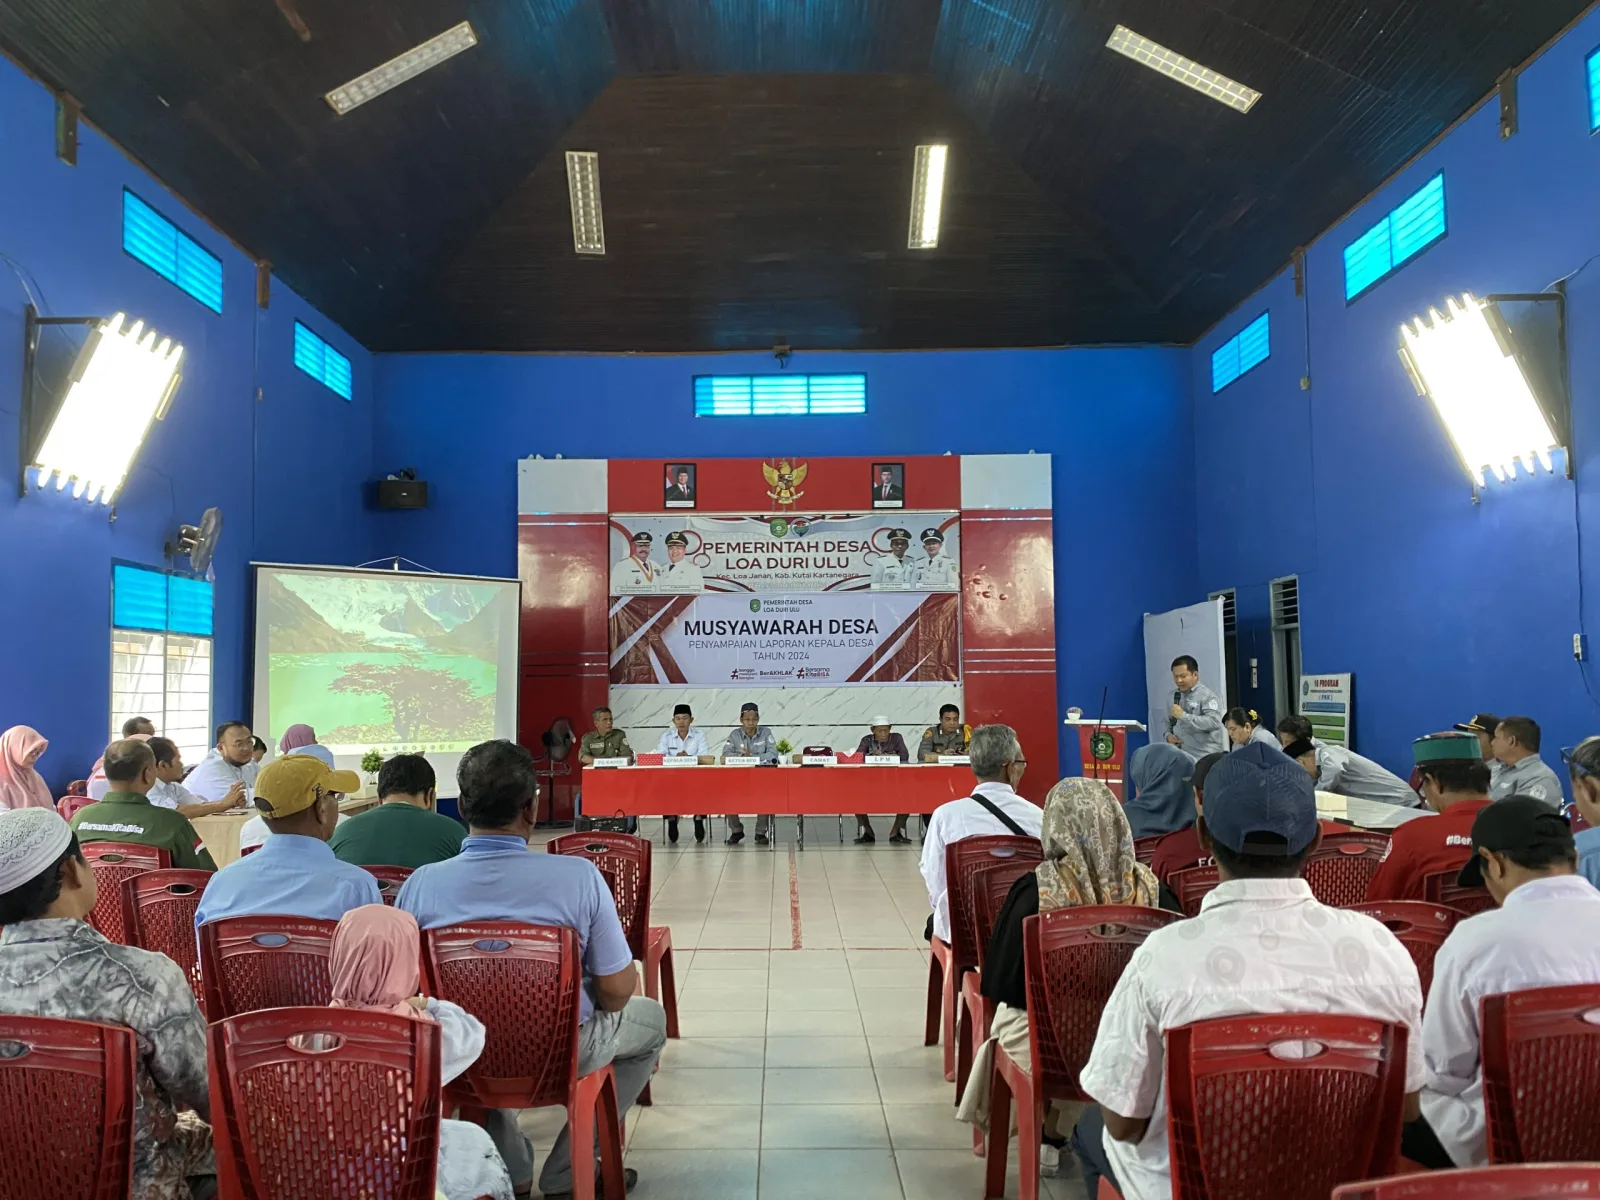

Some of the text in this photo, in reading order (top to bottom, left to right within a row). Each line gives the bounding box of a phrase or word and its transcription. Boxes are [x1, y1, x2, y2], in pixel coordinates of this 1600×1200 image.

[703, 540, 872, 554] PEMERINTAH DESA
[726, 556, 850, 570] LOA DURI ULU
[813, 572, 859, 580] Kartanegara
[684, 618, 879, 636] MUSYAWARAH DESA
[688, 638, 874, 649] PENYAMPAIAN LAPORAN KEPALA DESA
[753, 651, 810, 661] TAHUN 2024
[1446, 835, 1474, 846] #Ber
